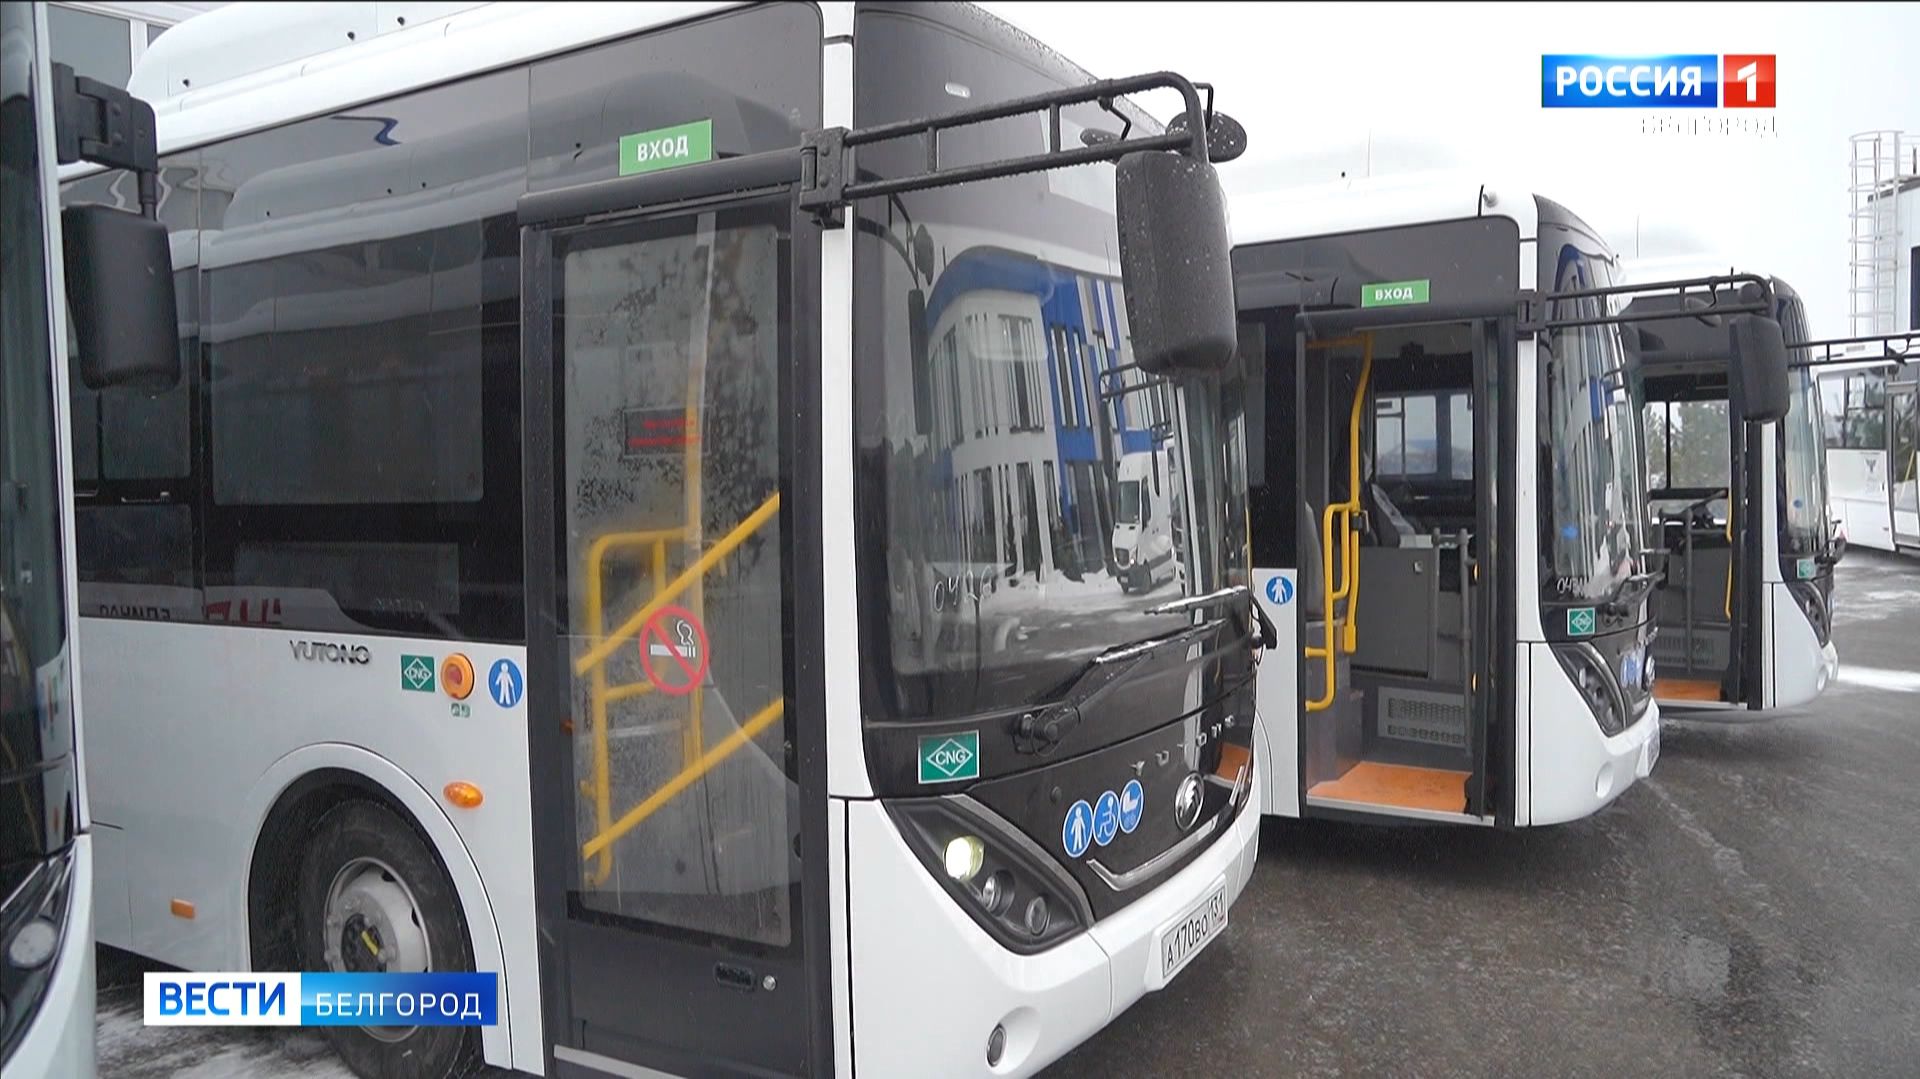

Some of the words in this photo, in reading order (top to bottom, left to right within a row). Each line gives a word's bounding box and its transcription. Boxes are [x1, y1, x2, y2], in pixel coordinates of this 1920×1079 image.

[637, 134, 689, 162] ВХОД
[1375, 287, 1413, 301] ВХОД
[935, 748, 966, 766] CNG
